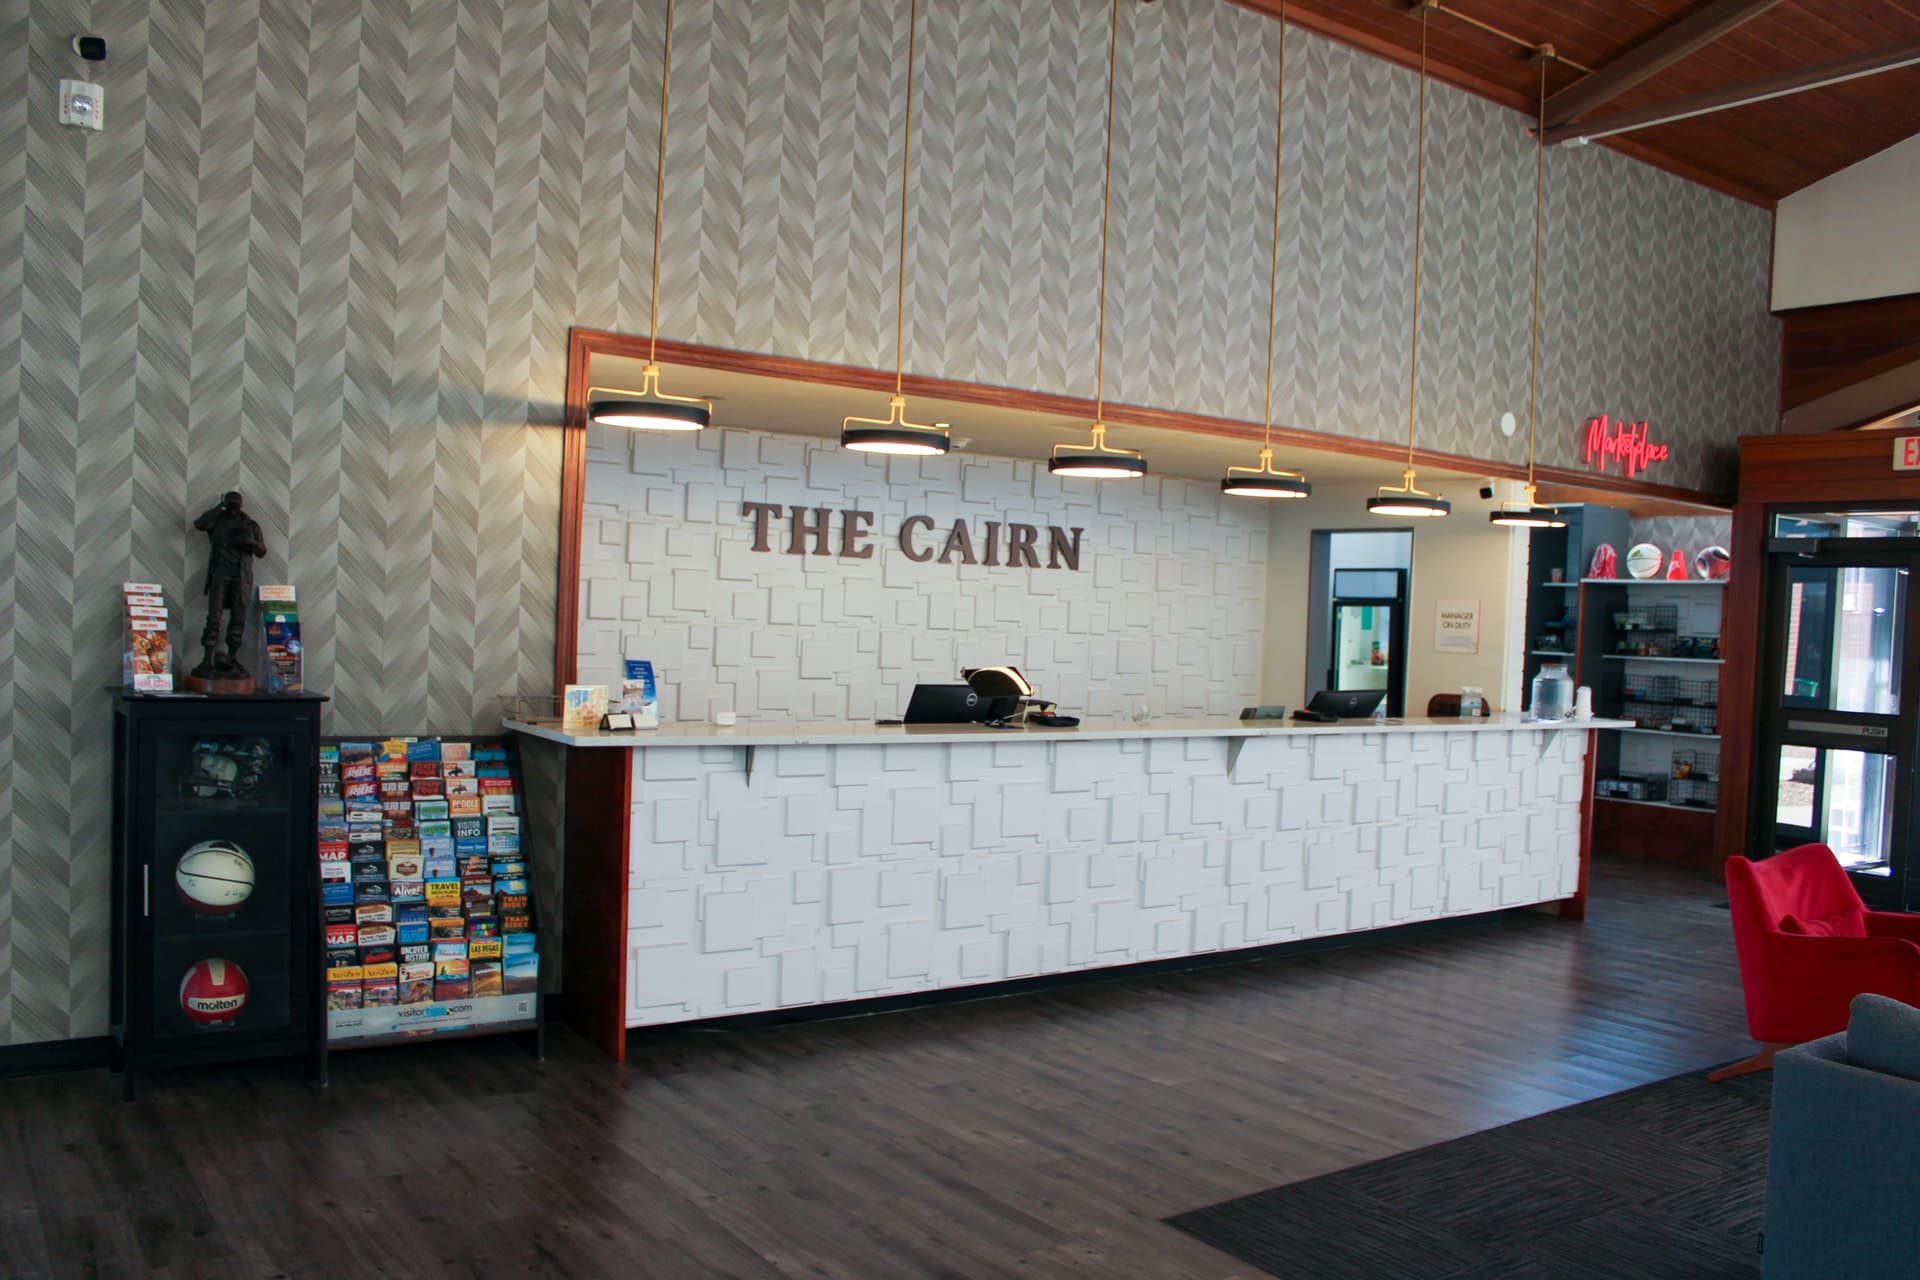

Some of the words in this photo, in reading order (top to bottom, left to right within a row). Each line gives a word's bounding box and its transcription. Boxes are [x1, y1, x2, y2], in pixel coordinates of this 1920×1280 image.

[1585, 413, 1669, 478] Marketplace
[742, 501, 874, 559] THE
[899, 514, 1085, 571] CAIRN
[1441, 612, 1473, 620] MANAGER
[1442, 621, 1453, 629] ON
[1455, 622, 1471, 630] DUTY
[1862, 727, 1885, 736] PUSH
[457, 821, 480, 829] VISITOR
[457, 829, 480, 837] INFO
[320, 852, 346, 861] MAP
[394, 885, 420, 896] Alive!
[327, 935, 354, 944] MAP
[471, 945, 482, 953] LAS
[483, 944, 499, 952] VEGAS
[197, 998, 238, 1011] molten
